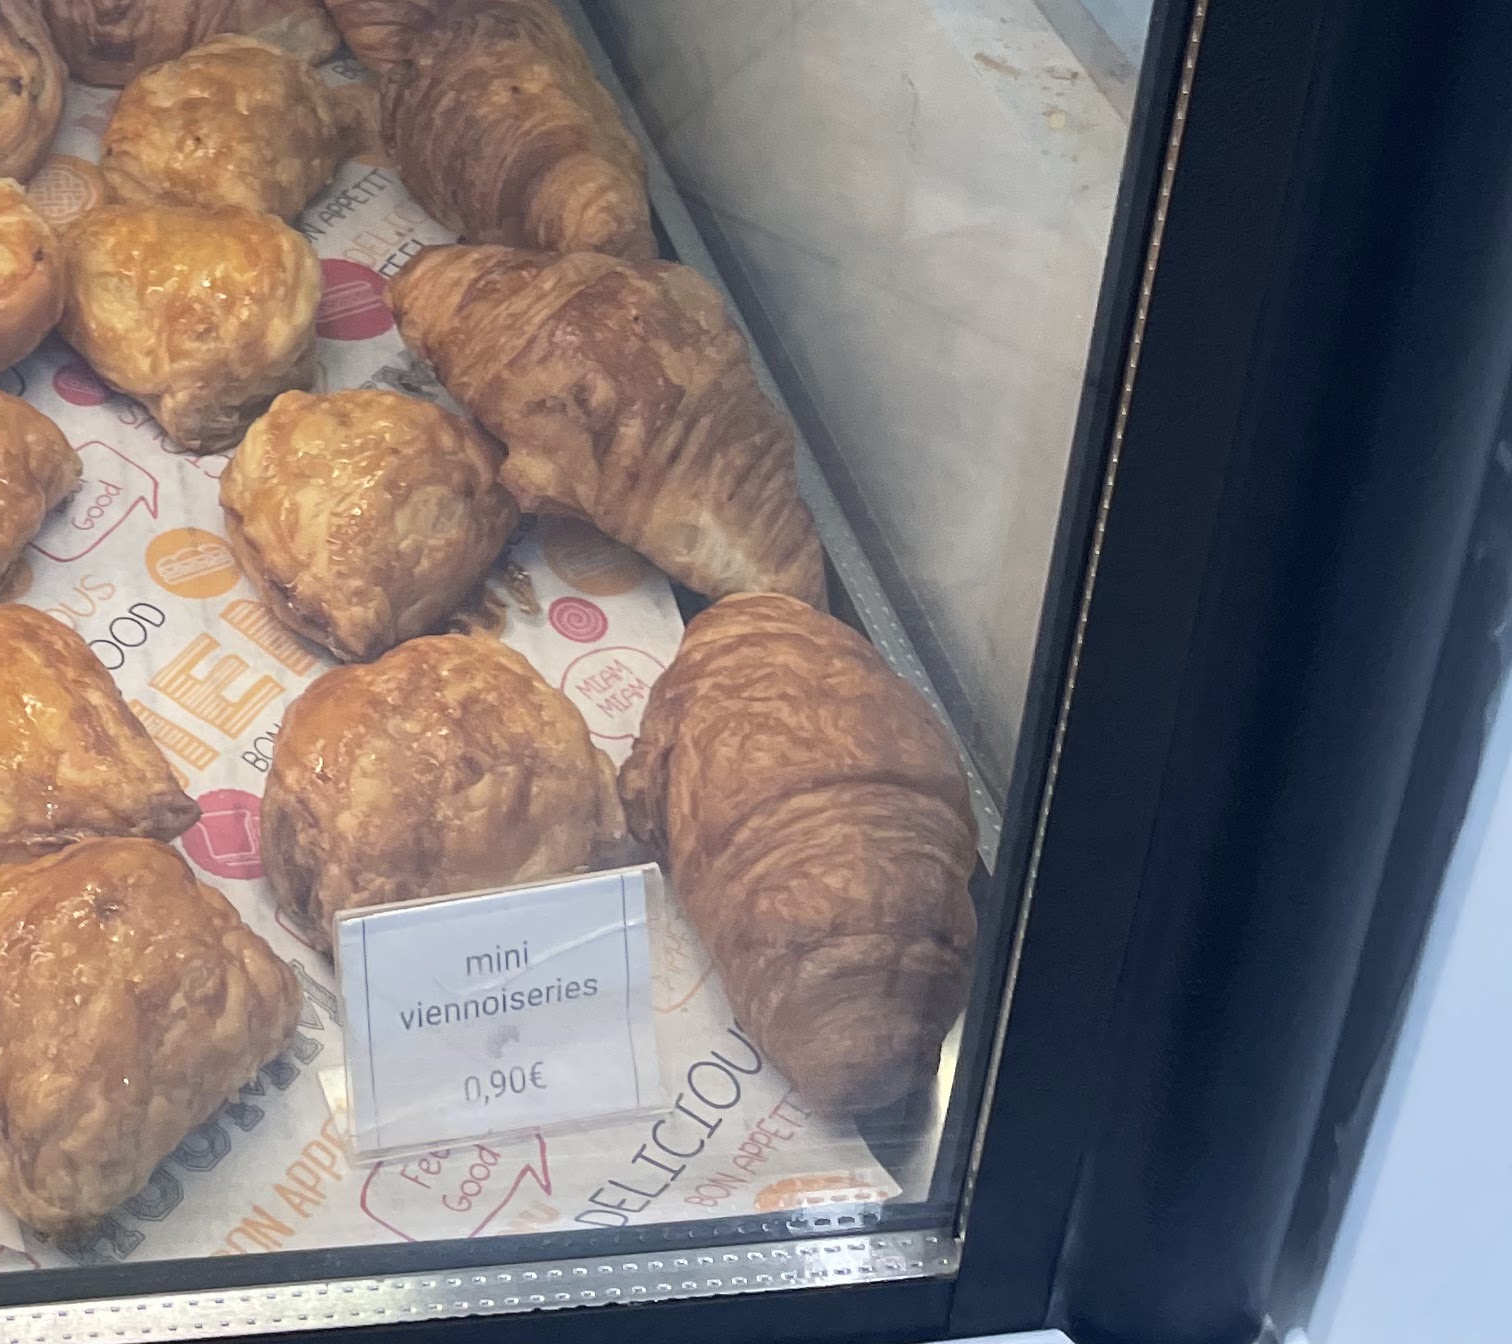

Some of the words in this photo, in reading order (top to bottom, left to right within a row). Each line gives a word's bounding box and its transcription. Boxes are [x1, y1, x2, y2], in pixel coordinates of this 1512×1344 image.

[71, 478, 125, 531] Good
[88, 601, 166, 670] OOD
[576, 659, 635, 700] MIAM
[598, 679, 654, 720] MIAM
[466, 940, 530, 978] mini
[399, 974, 599, 1031] viennoiseries
[464, 1061, 548, 1105] 0,90€
[574, 1018, 762, 1228] DELICIOU
[442, 1143, 502, 1213] Good
[683, 1169, 748, 1208] BON
[211, 1204, 296, 1257] ON
